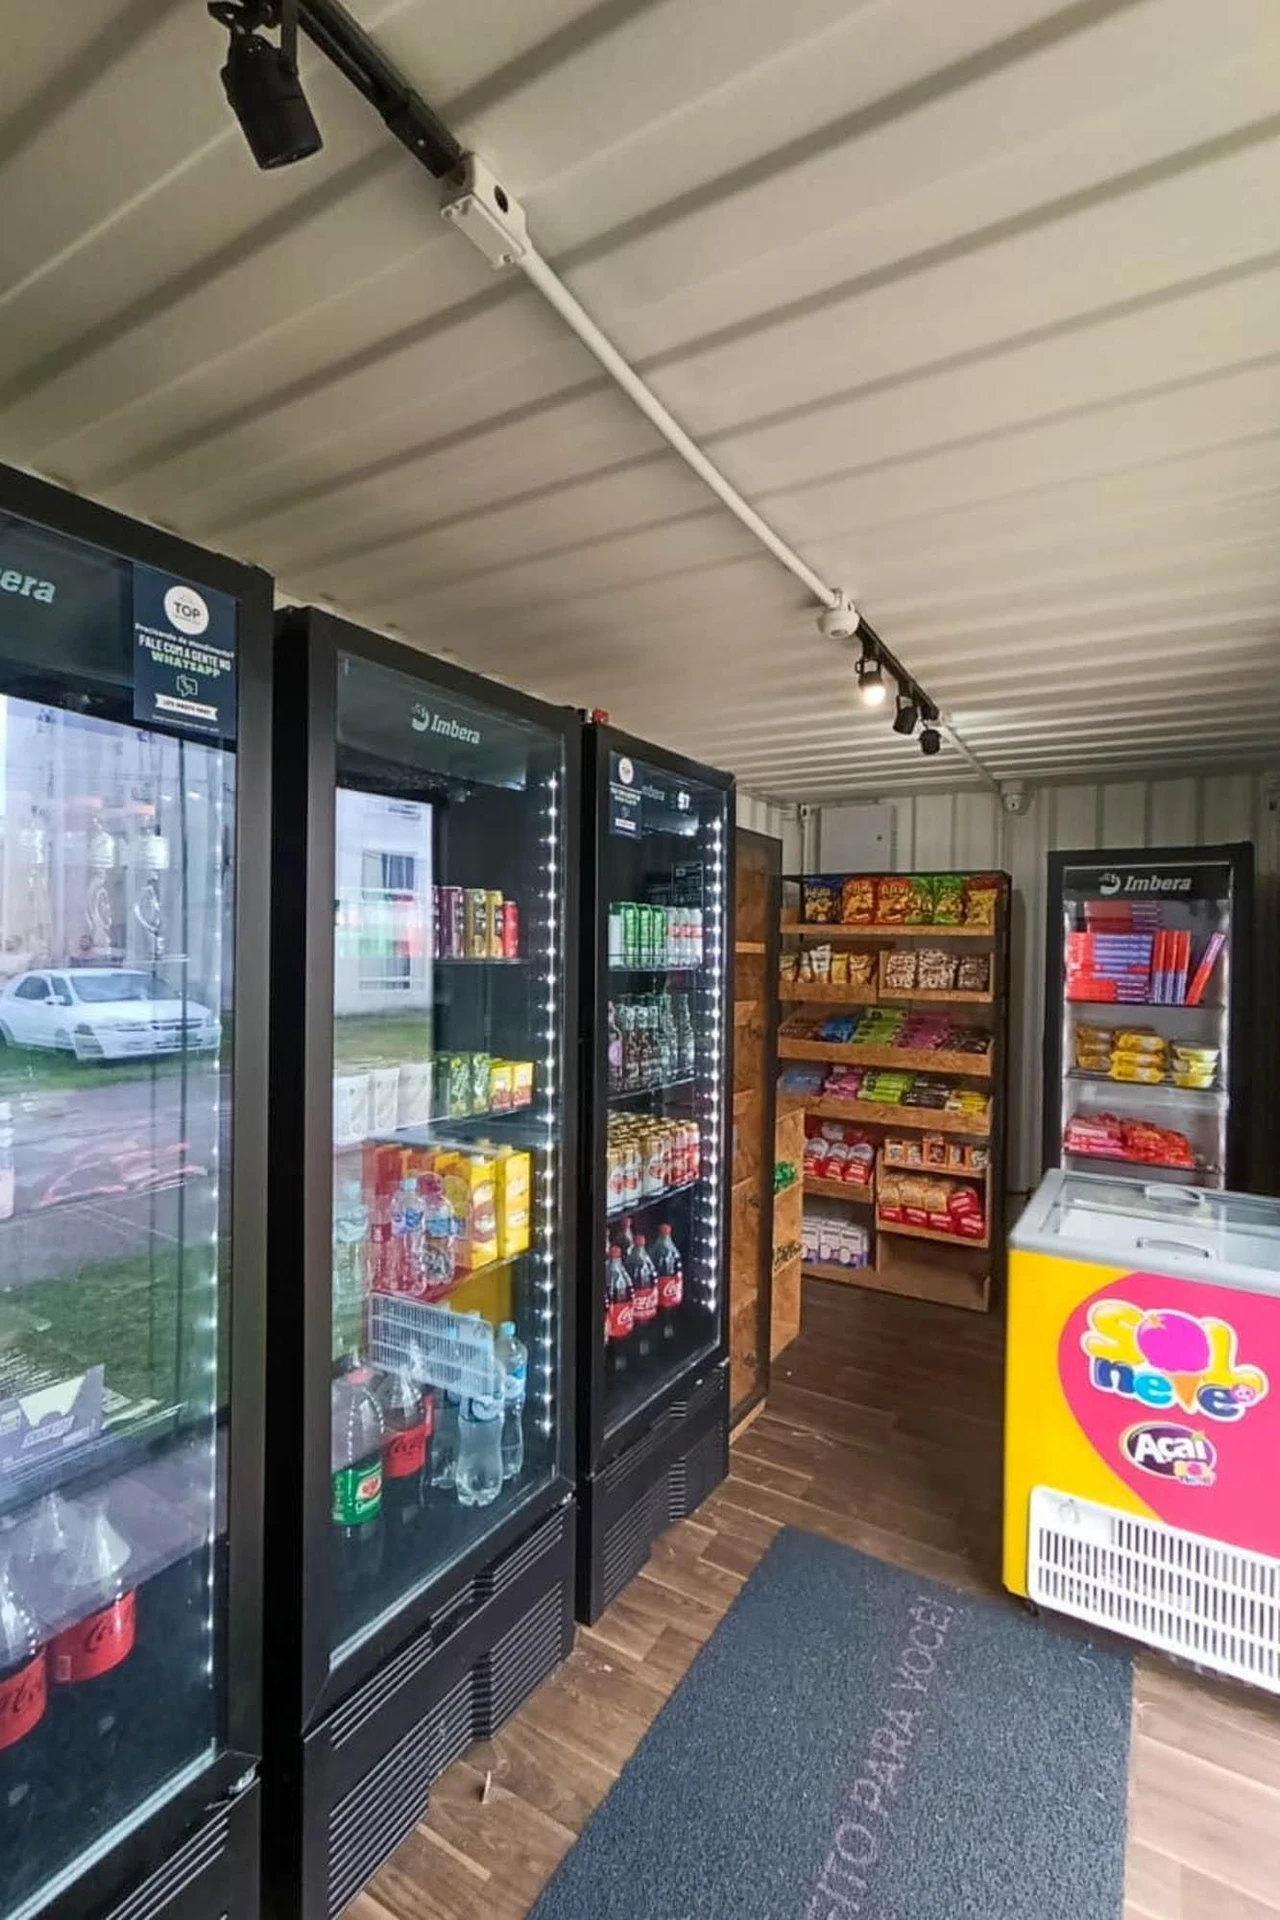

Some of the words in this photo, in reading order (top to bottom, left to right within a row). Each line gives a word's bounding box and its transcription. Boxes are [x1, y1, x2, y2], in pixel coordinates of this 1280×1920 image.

[0, 569, 56, 603] era
[173, 601, 201, 619] TOP
[139, 634, 163, 651] FALE
[164, 642, 184, 657] COM
[150, 650, 221, 678] WHATSAPP
[430, 713, 480, 744] Imbera
[1123, 874, 1193, 892] Imbera
[850, 1706, 922, 1818] PARA
